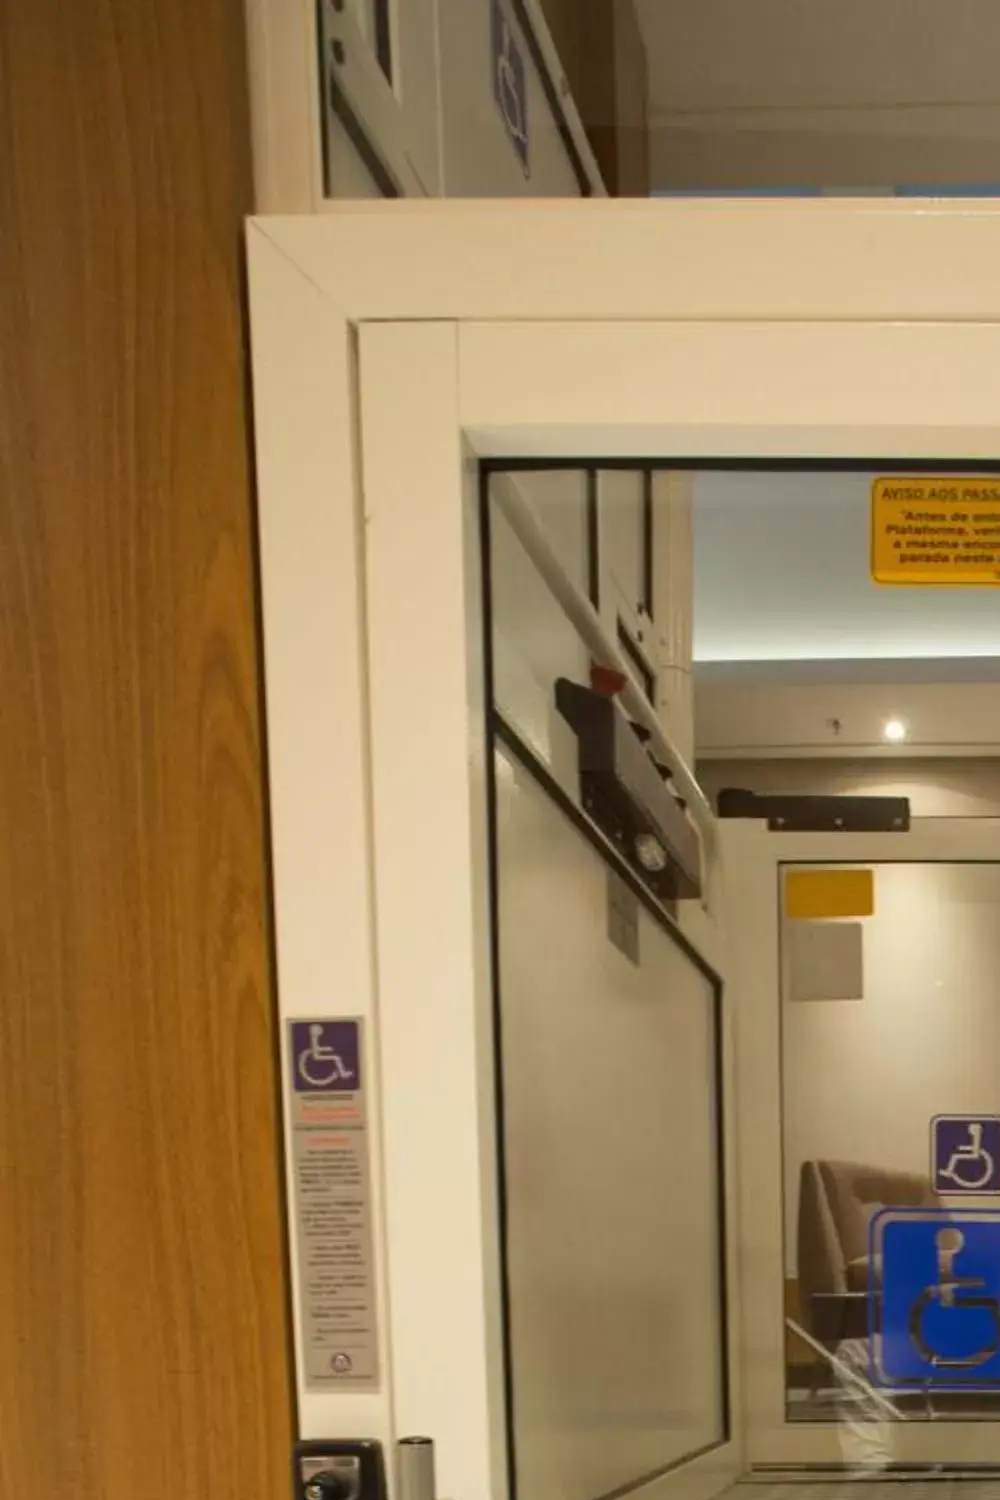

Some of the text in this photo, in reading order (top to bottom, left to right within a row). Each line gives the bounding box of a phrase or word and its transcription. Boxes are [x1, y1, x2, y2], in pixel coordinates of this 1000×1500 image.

[882, 487, 924, 500] AVISO
[928, 487, 958, 501] AOS
[950, 511, 968, 522] de
[893, 541, 901, 549] a
[905, 540, 958, 549] mesma
[900, 552, 950, 565] parada
[954, 553, 994, 564] neste
